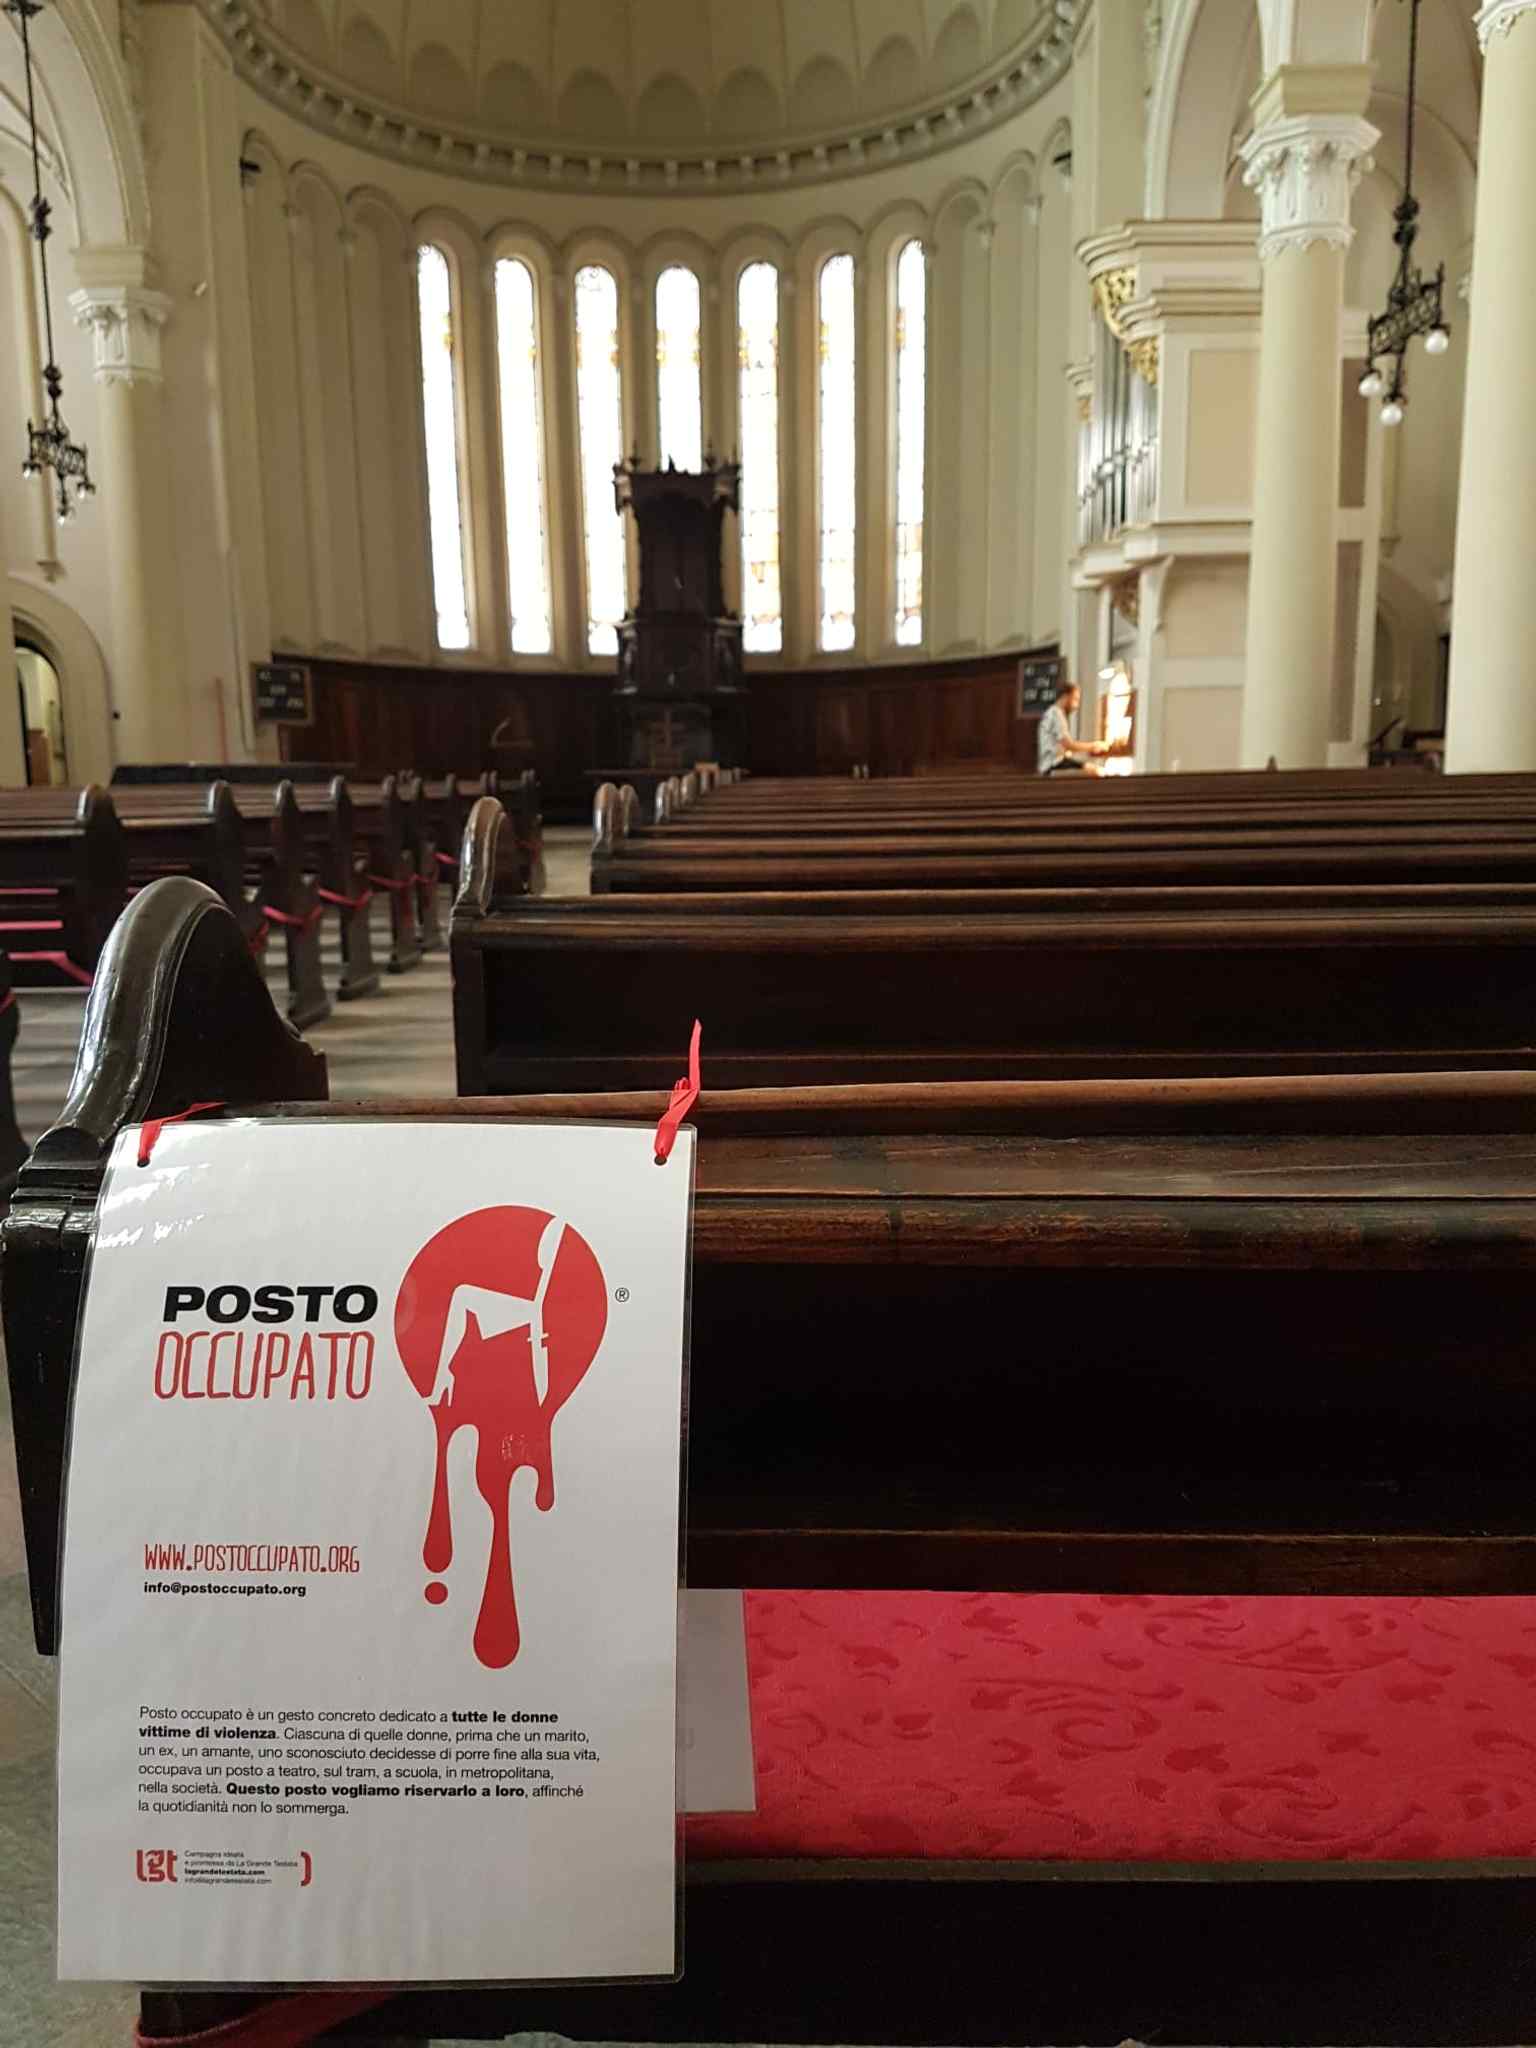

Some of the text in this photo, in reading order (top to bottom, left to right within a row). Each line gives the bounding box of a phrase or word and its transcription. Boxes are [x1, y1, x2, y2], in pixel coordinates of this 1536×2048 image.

[163, 1284, 378, 1323] POSTO
[155, 1330, 375, 1400] OCCUPATO
[144, 1543, 360, 1573] WWW.POSTOCCUPATO.ORG
[144, 1581, 307, 1597] info@postoccupato.org
[140, 1706, 558, 1724] Posto occupato è un gesto concreto dedicato a tutte le donne
[139, 1725, 589, 1745] vittime di violenza. Ciascuna di quelle donne, prima che un marito,
[138, 1744, 600, 1763] un ex, un amante, uno sconosciuto decidesse di porre fine alla sua vita,
[138, 1763, 554, 1782] occupava un posto a teatro, sul tram, a scuola, in metropolitana,
[139, 1780, 584, 1799] nella società. Questo posto vogliamo riservarlo a loro, affinché
[138, 1798, 349, 1817] la quotidianità non lo sommerga.
[184, 1868, 265, 1876] lagrandetestata.com
